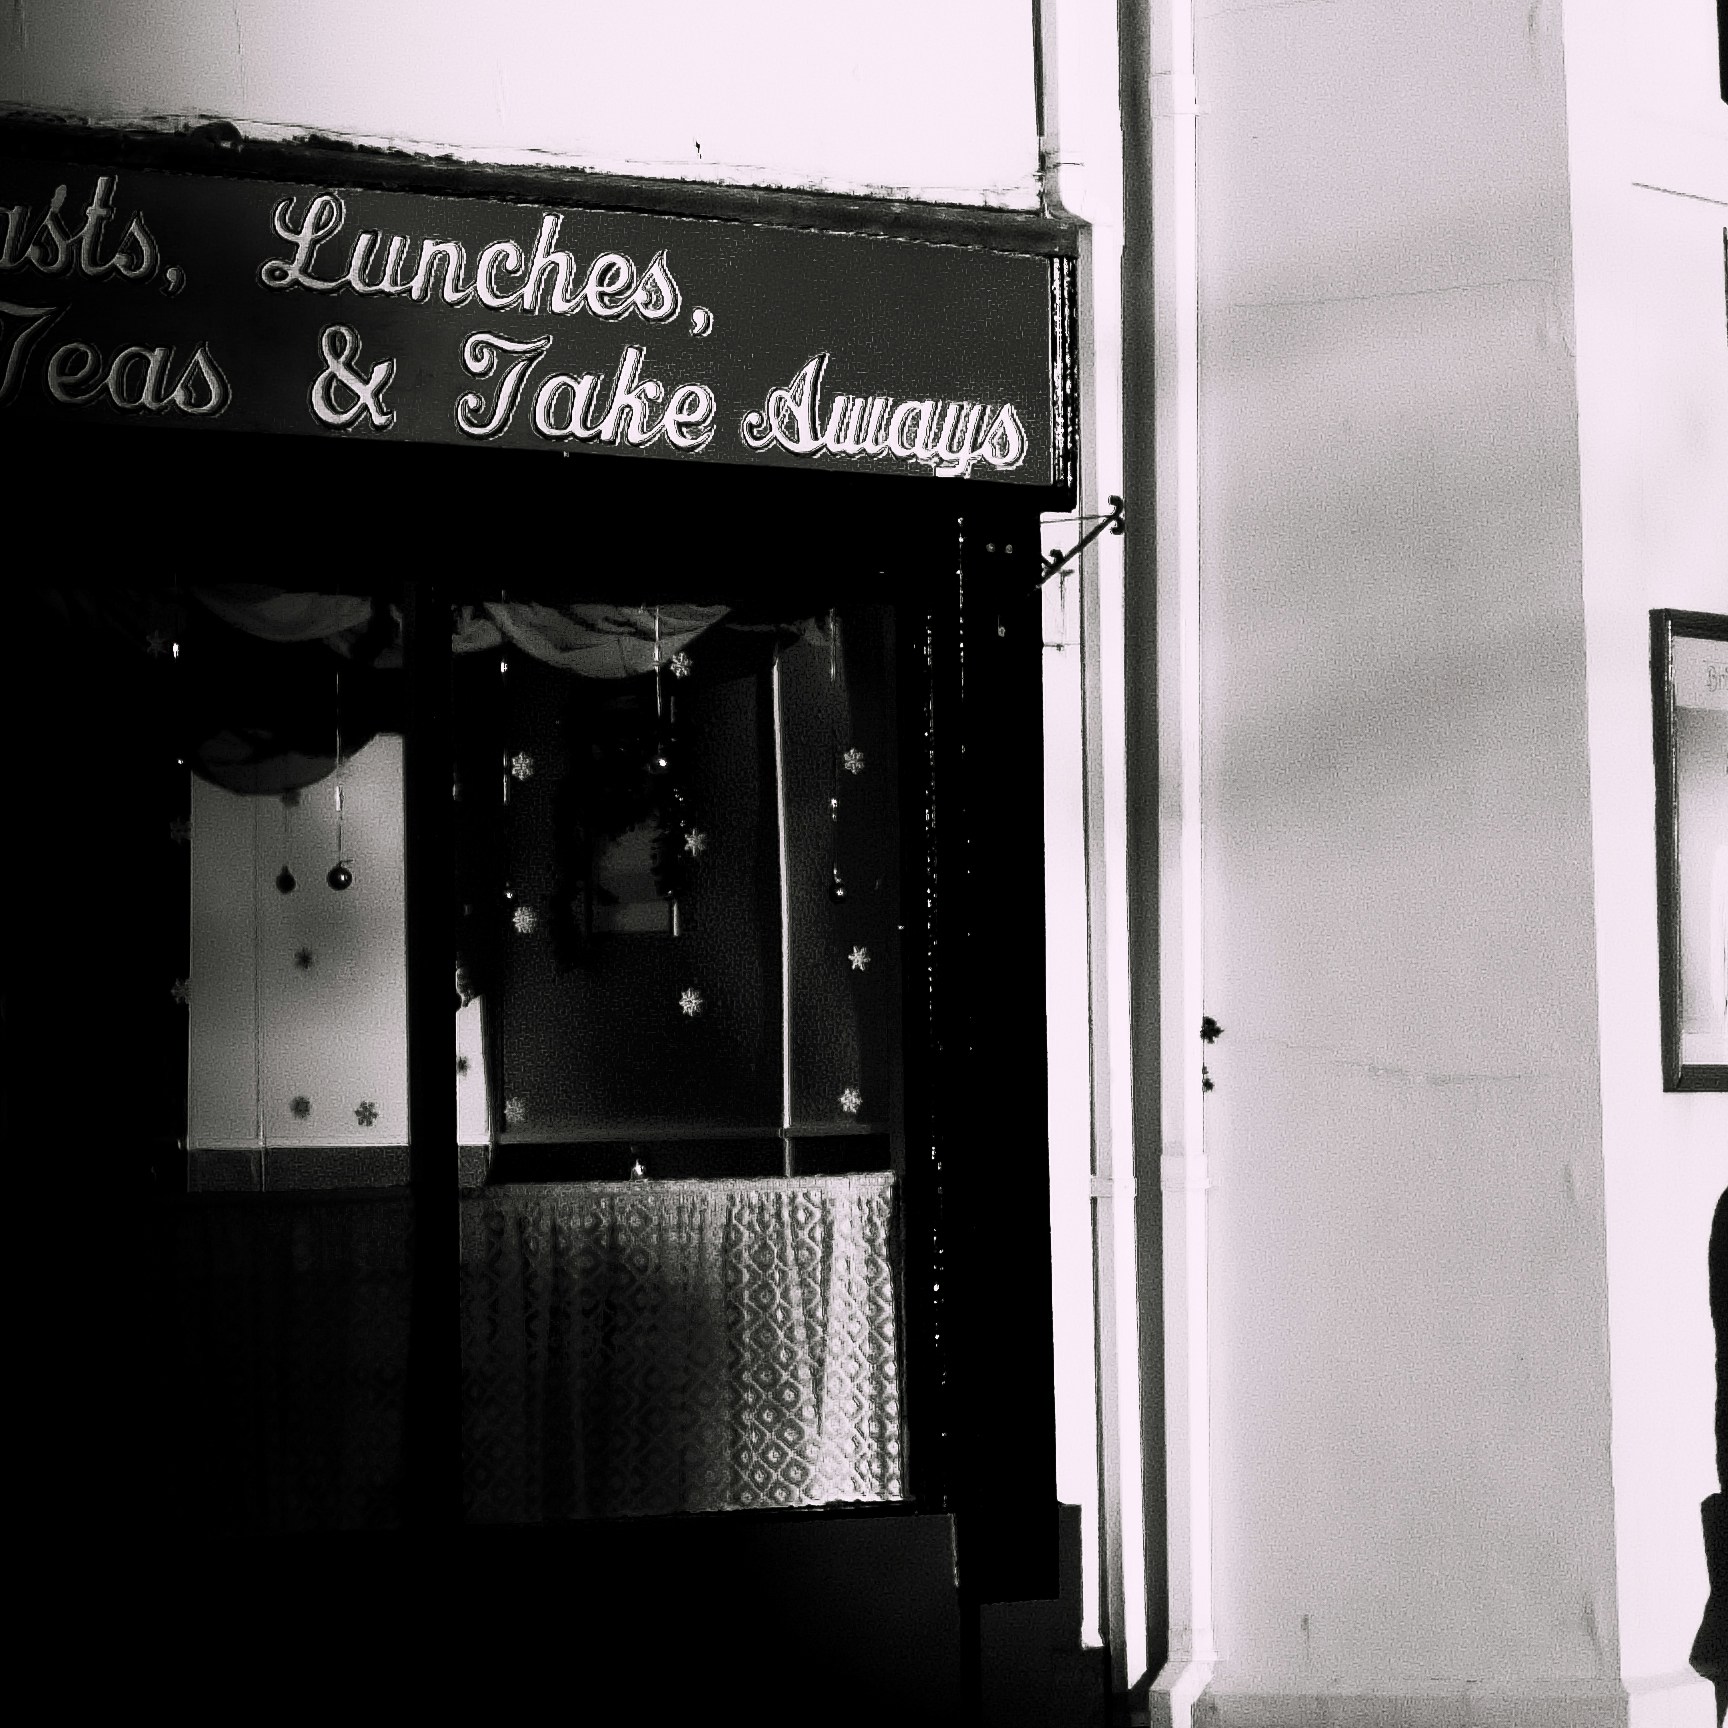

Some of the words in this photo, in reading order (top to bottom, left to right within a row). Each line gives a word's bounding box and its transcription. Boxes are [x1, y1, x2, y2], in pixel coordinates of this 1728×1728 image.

[258, 191, 714, 337] Lunches,
[0, 302, 232, 418] Teas
[308, 323, 397, 432] &
[454, 330, 717, 453] Take
[740, 351, 1028, 479] Aways
